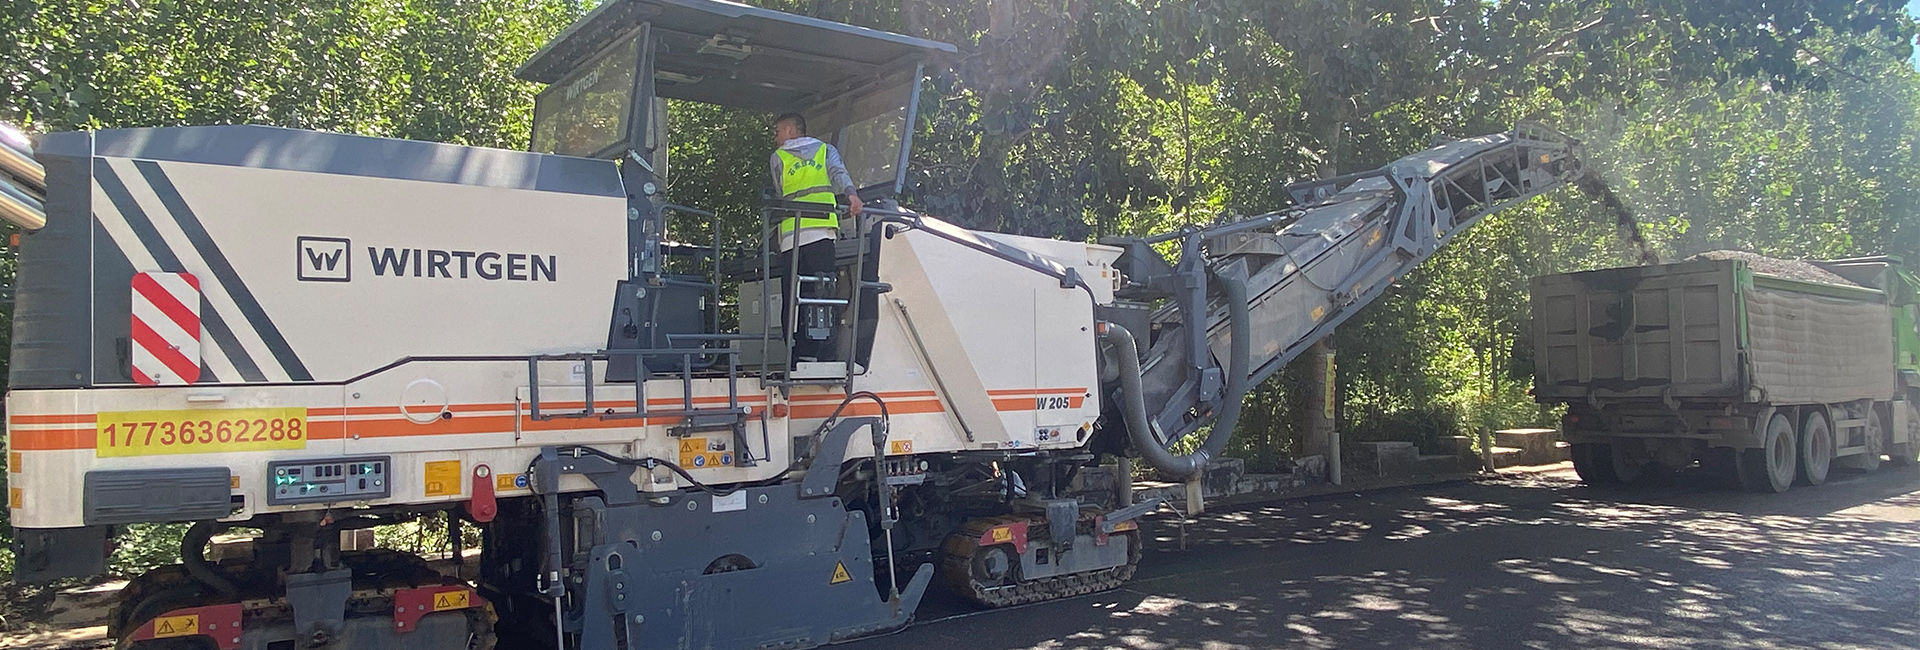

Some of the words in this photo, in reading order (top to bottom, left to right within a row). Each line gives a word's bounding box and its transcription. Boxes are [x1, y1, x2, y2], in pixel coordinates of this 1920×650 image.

[367, 246, 557, 282] WIRTGEN
[1037, 397, 1047, 409] W
[1049, 397, 1069, 409] 205
[103, 417, 302, 447] 17736362288
